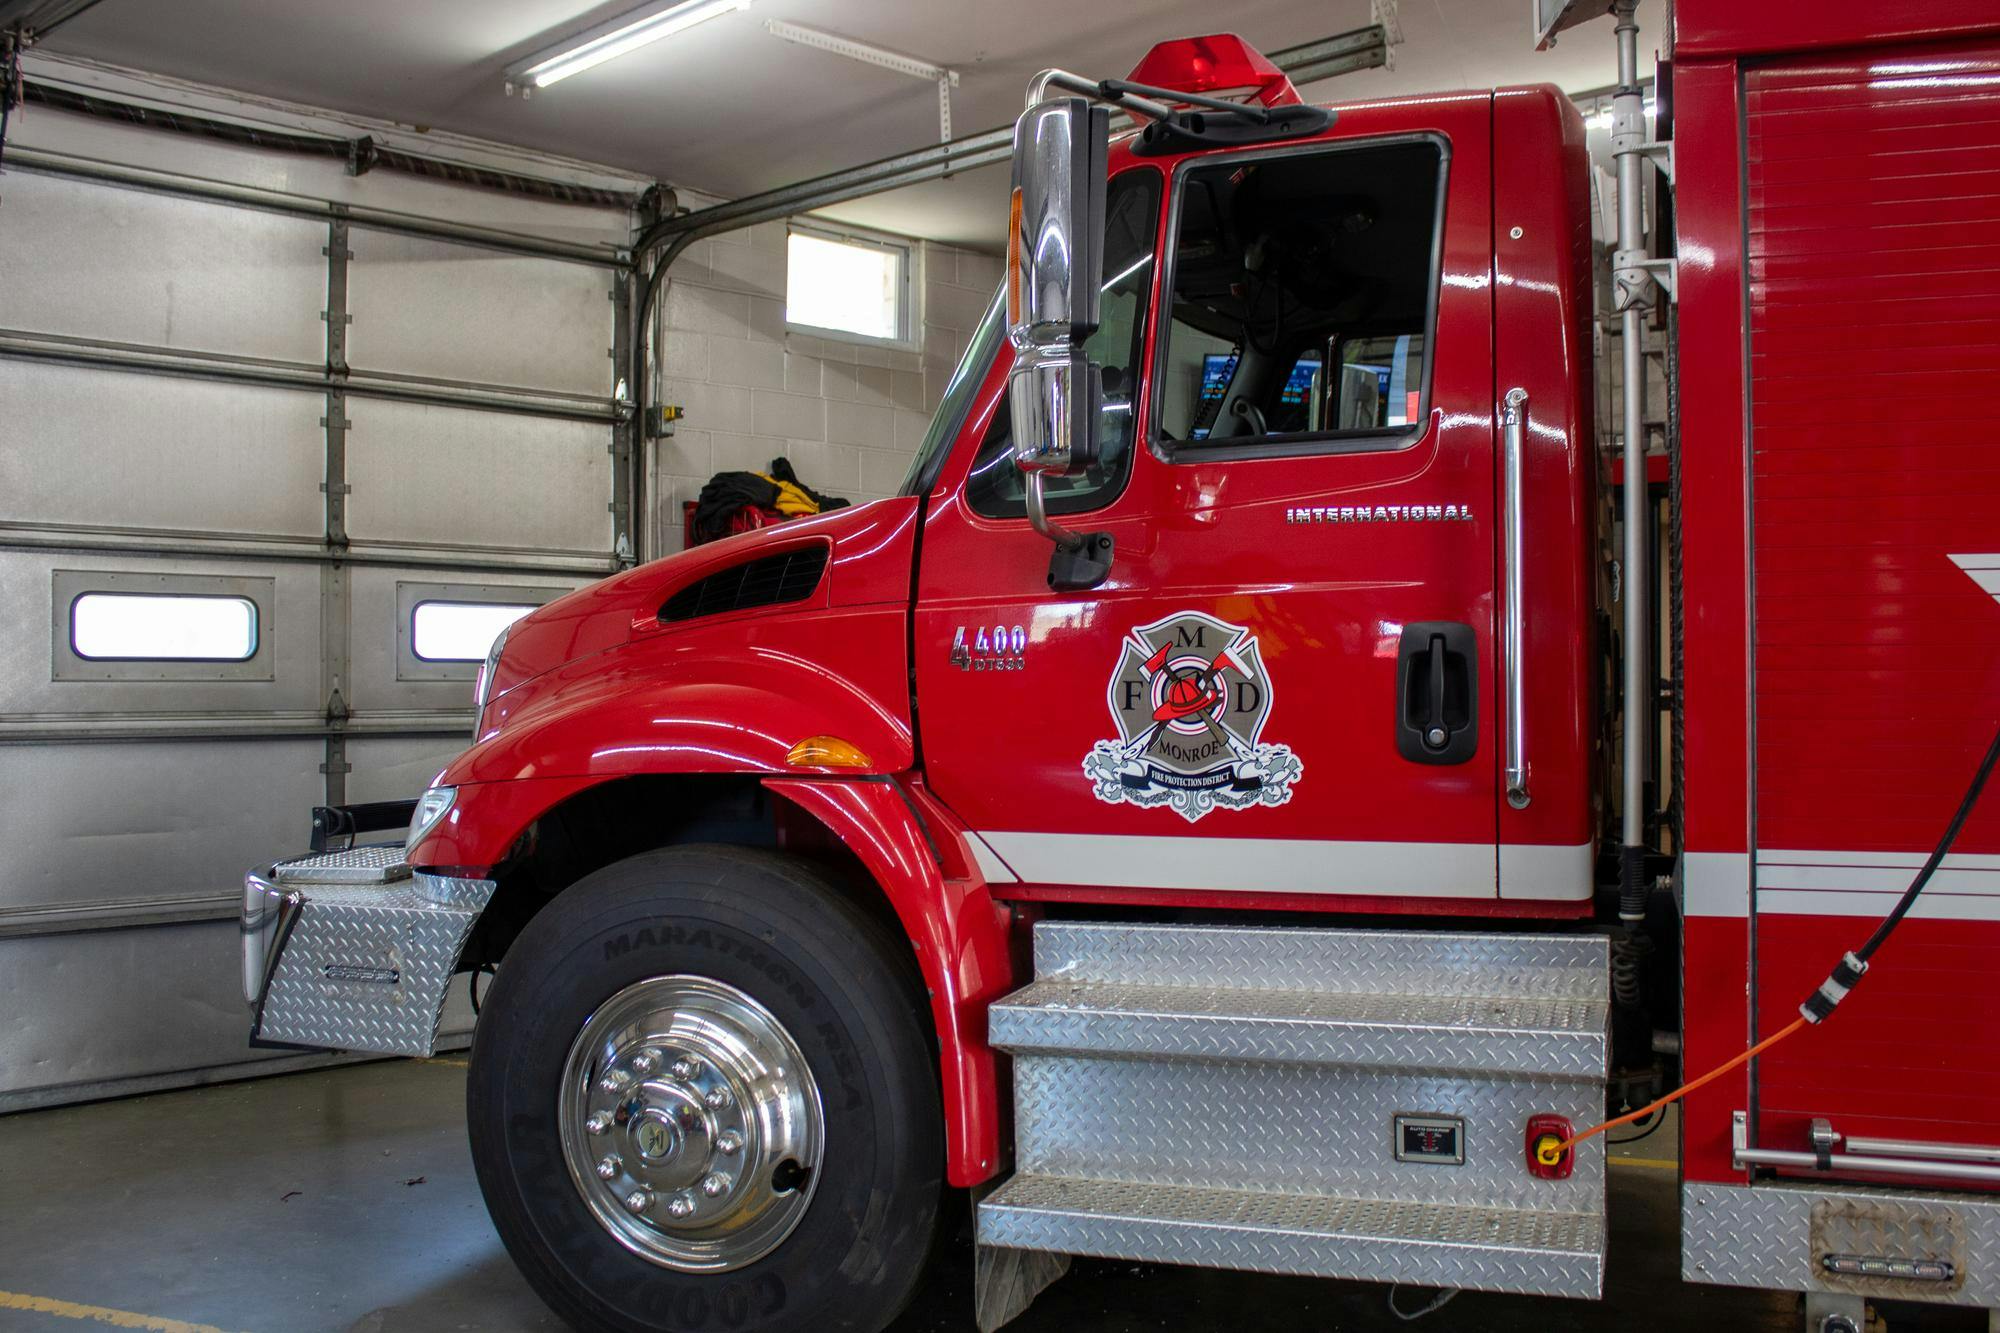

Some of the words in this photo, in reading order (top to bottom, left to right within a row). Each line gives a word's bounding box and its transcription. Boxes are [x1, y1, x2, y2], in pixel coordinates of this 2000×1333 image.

[1286, 505, 1474, 523] INTERNATIONAL
[951, 625, 1025, 671] 4400
[1175, 626, 1206, 648] M
[1122, 681, 1144, 711] F
[1234, 682, 1261, 713] D
[1159, 741, 1220, 762] MONROE
[1151, 770, 1164, 782] FIRE
[1164, 775, 1202, 787] PROTECTION
[1202, 772, 1230, 786] DISTRICT
[603, 926, 817, 1009] MARATHON
